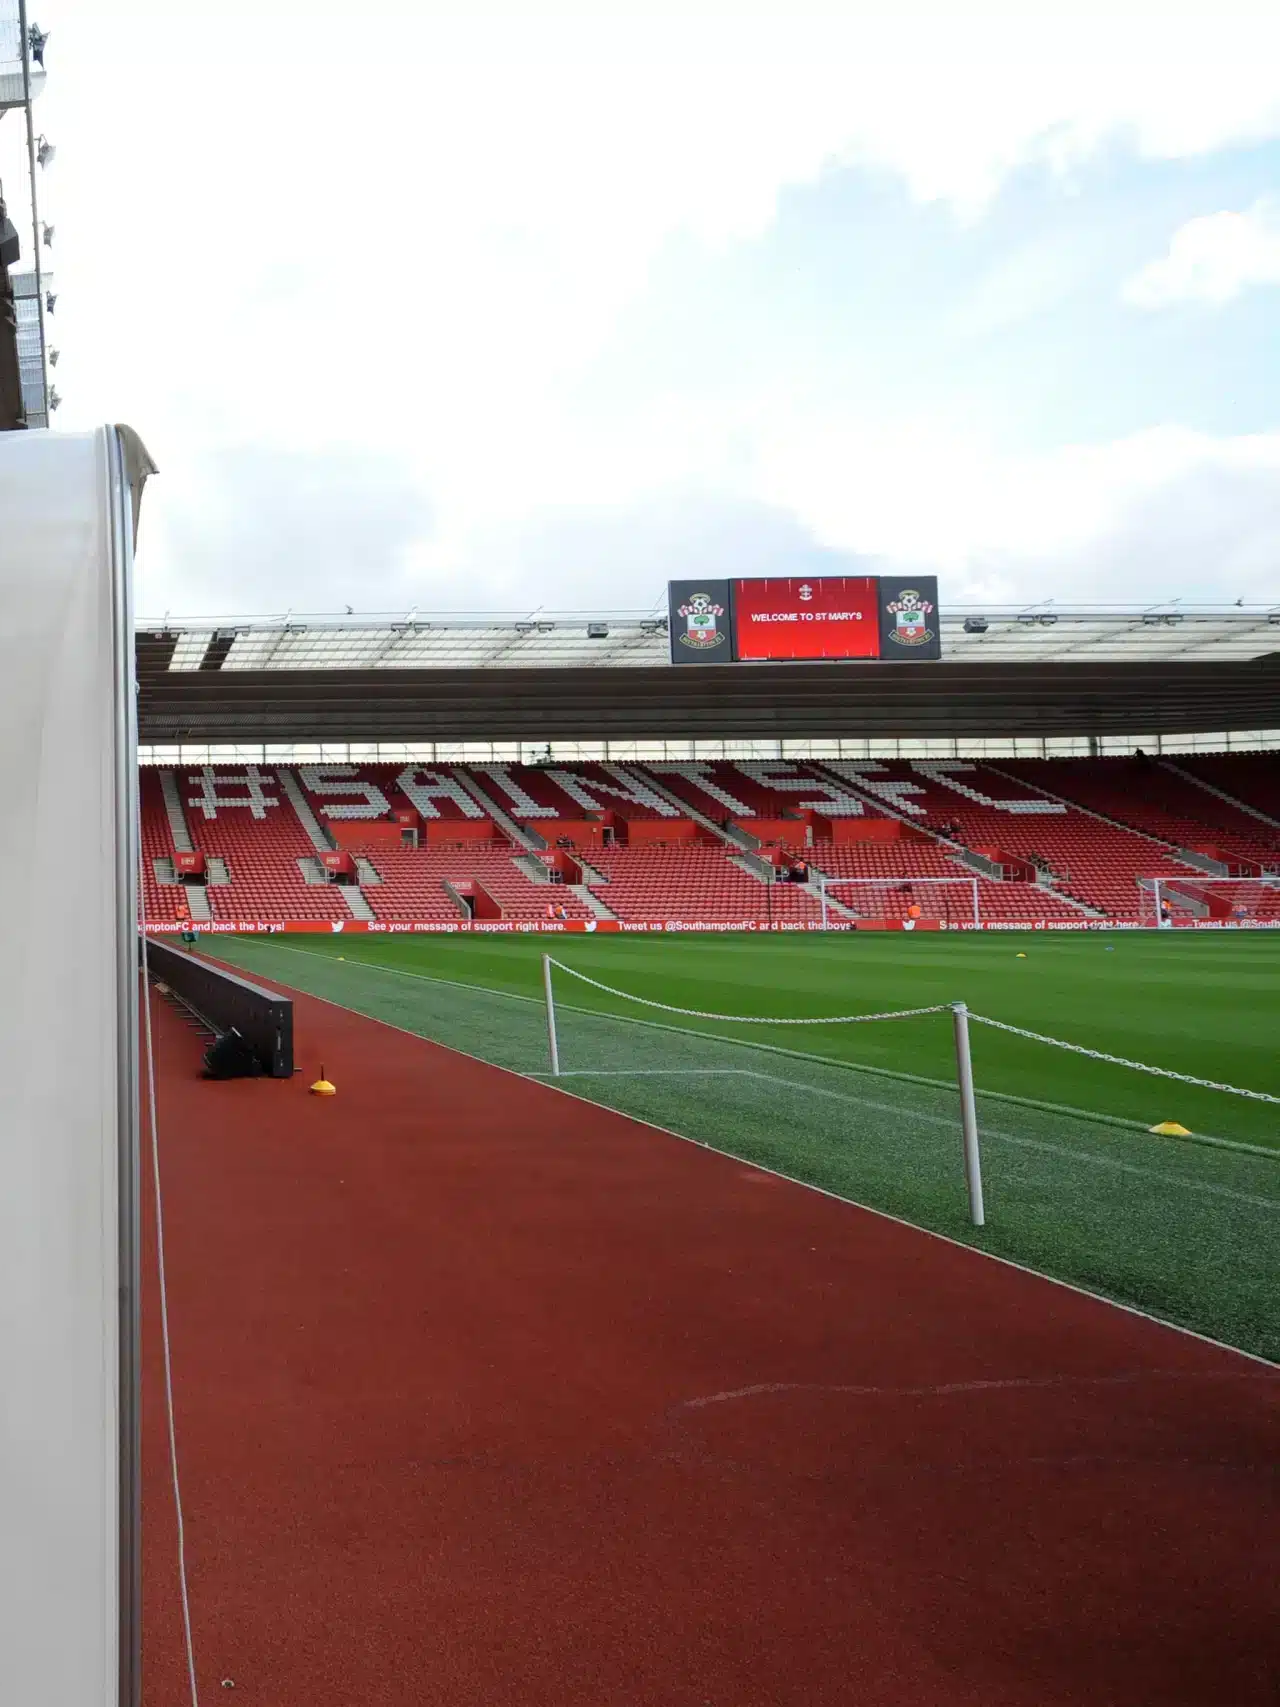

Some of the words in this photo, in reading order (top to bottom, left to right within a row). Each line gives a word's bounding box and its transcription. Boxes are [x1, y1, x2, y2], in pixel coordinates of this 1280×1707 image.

[751, 613, 798, 622] WELCOME
[800, 613, 814, 621] TO
[815, 612, 828, 621] ST
[829, 612, 862, 620] MARY'S
[191, 921, 210, 931] and
[213, 921, 237, 931] back
[239, 921, 255, 931] the
[367, 921, 386, 931] See
[388, 923, 412, 932] your
[414, 923, 459, 932] message
[461, 921, 472, 931] of
[474, 922, 513, 932] support
[515, 921, 540, 932] right
[541, 921, 567, 931] here.
[617, 921, 648, 931] Tweet
[649, 923, 663, 931] us
[665, 920, 757, 931] @SouthamptonFC
[781, 921, 805, 930] back
[808, 921, 824, 930] the
[987, 922, 1033, 931] message
[1035, 920, 1046, 930] of
[1047, 921, 1089, 931] support
